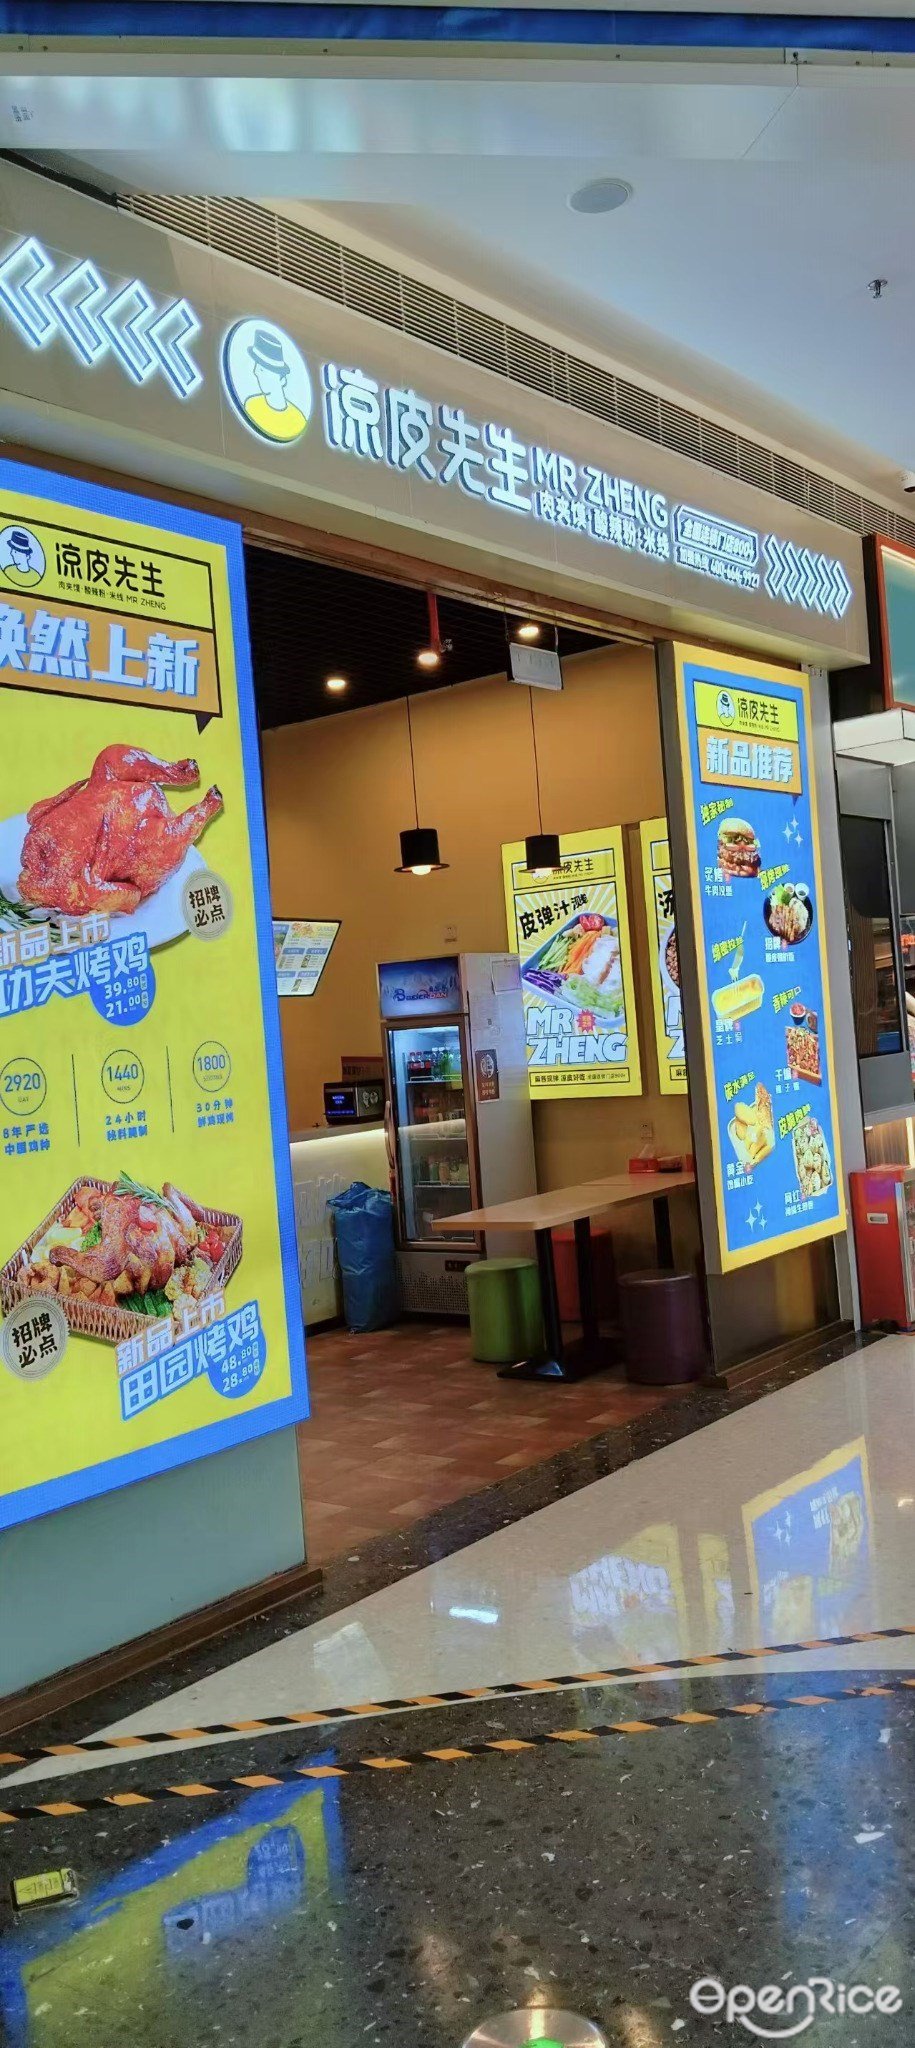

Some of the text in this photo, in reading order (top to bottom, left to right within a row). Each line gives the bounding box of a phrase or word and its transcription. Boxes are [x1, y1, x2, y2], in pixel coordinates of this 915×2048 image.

[322, 363, 532, 511] 凉皮先生
[531, 447, 669, 528] MR ZHENG
[55, 542, 166, 598] 凉皮先生
[126, 595, 138, 605] MR
[140, 598, 166, 611] ZHENG
[737, 697, 780, 725] 凉皮先生
[706, 736, 793, 783] 新品推荐
[188, 885, 221, 908] 招牌
[705, 885, 733, 896] 牛肉汉堡
[194, 904, 226, 928] 必点
[0, 935, 148, 1012] 功夫烤鸡
[104, 976, 139, 1000] 39.80
[772, 986, 801, 1014] 香辣可口
[105, 995, 141, 1019] 21.00
[526, 1006, 575, 1036] MR
[197, 1054, 226, 1072] 1800
[526, 1033, 628, 1065] ZHENG
[4, 1072, 41, 1093] 2920
[106, 1064, 139, 1082] 1440
[105, 1110, 146, 1126] 24小时
[196, 1098, 234, 1113] 30分钟
[2, 1122, 49, 1140] 8年严选
[4, 1138, 50, 1156] 中国鸡种
[12, 1311, 53, 1347] 招牌
[117, 1290, 226, 1375] 新品上市
[18, 1334, 58, 1369] 必点
[121, 1302, 260, 1421] 田园烤鸡
[221, 1345, 252, 1374] 48.80
[222, 1364, 253, 1393] 28.80
